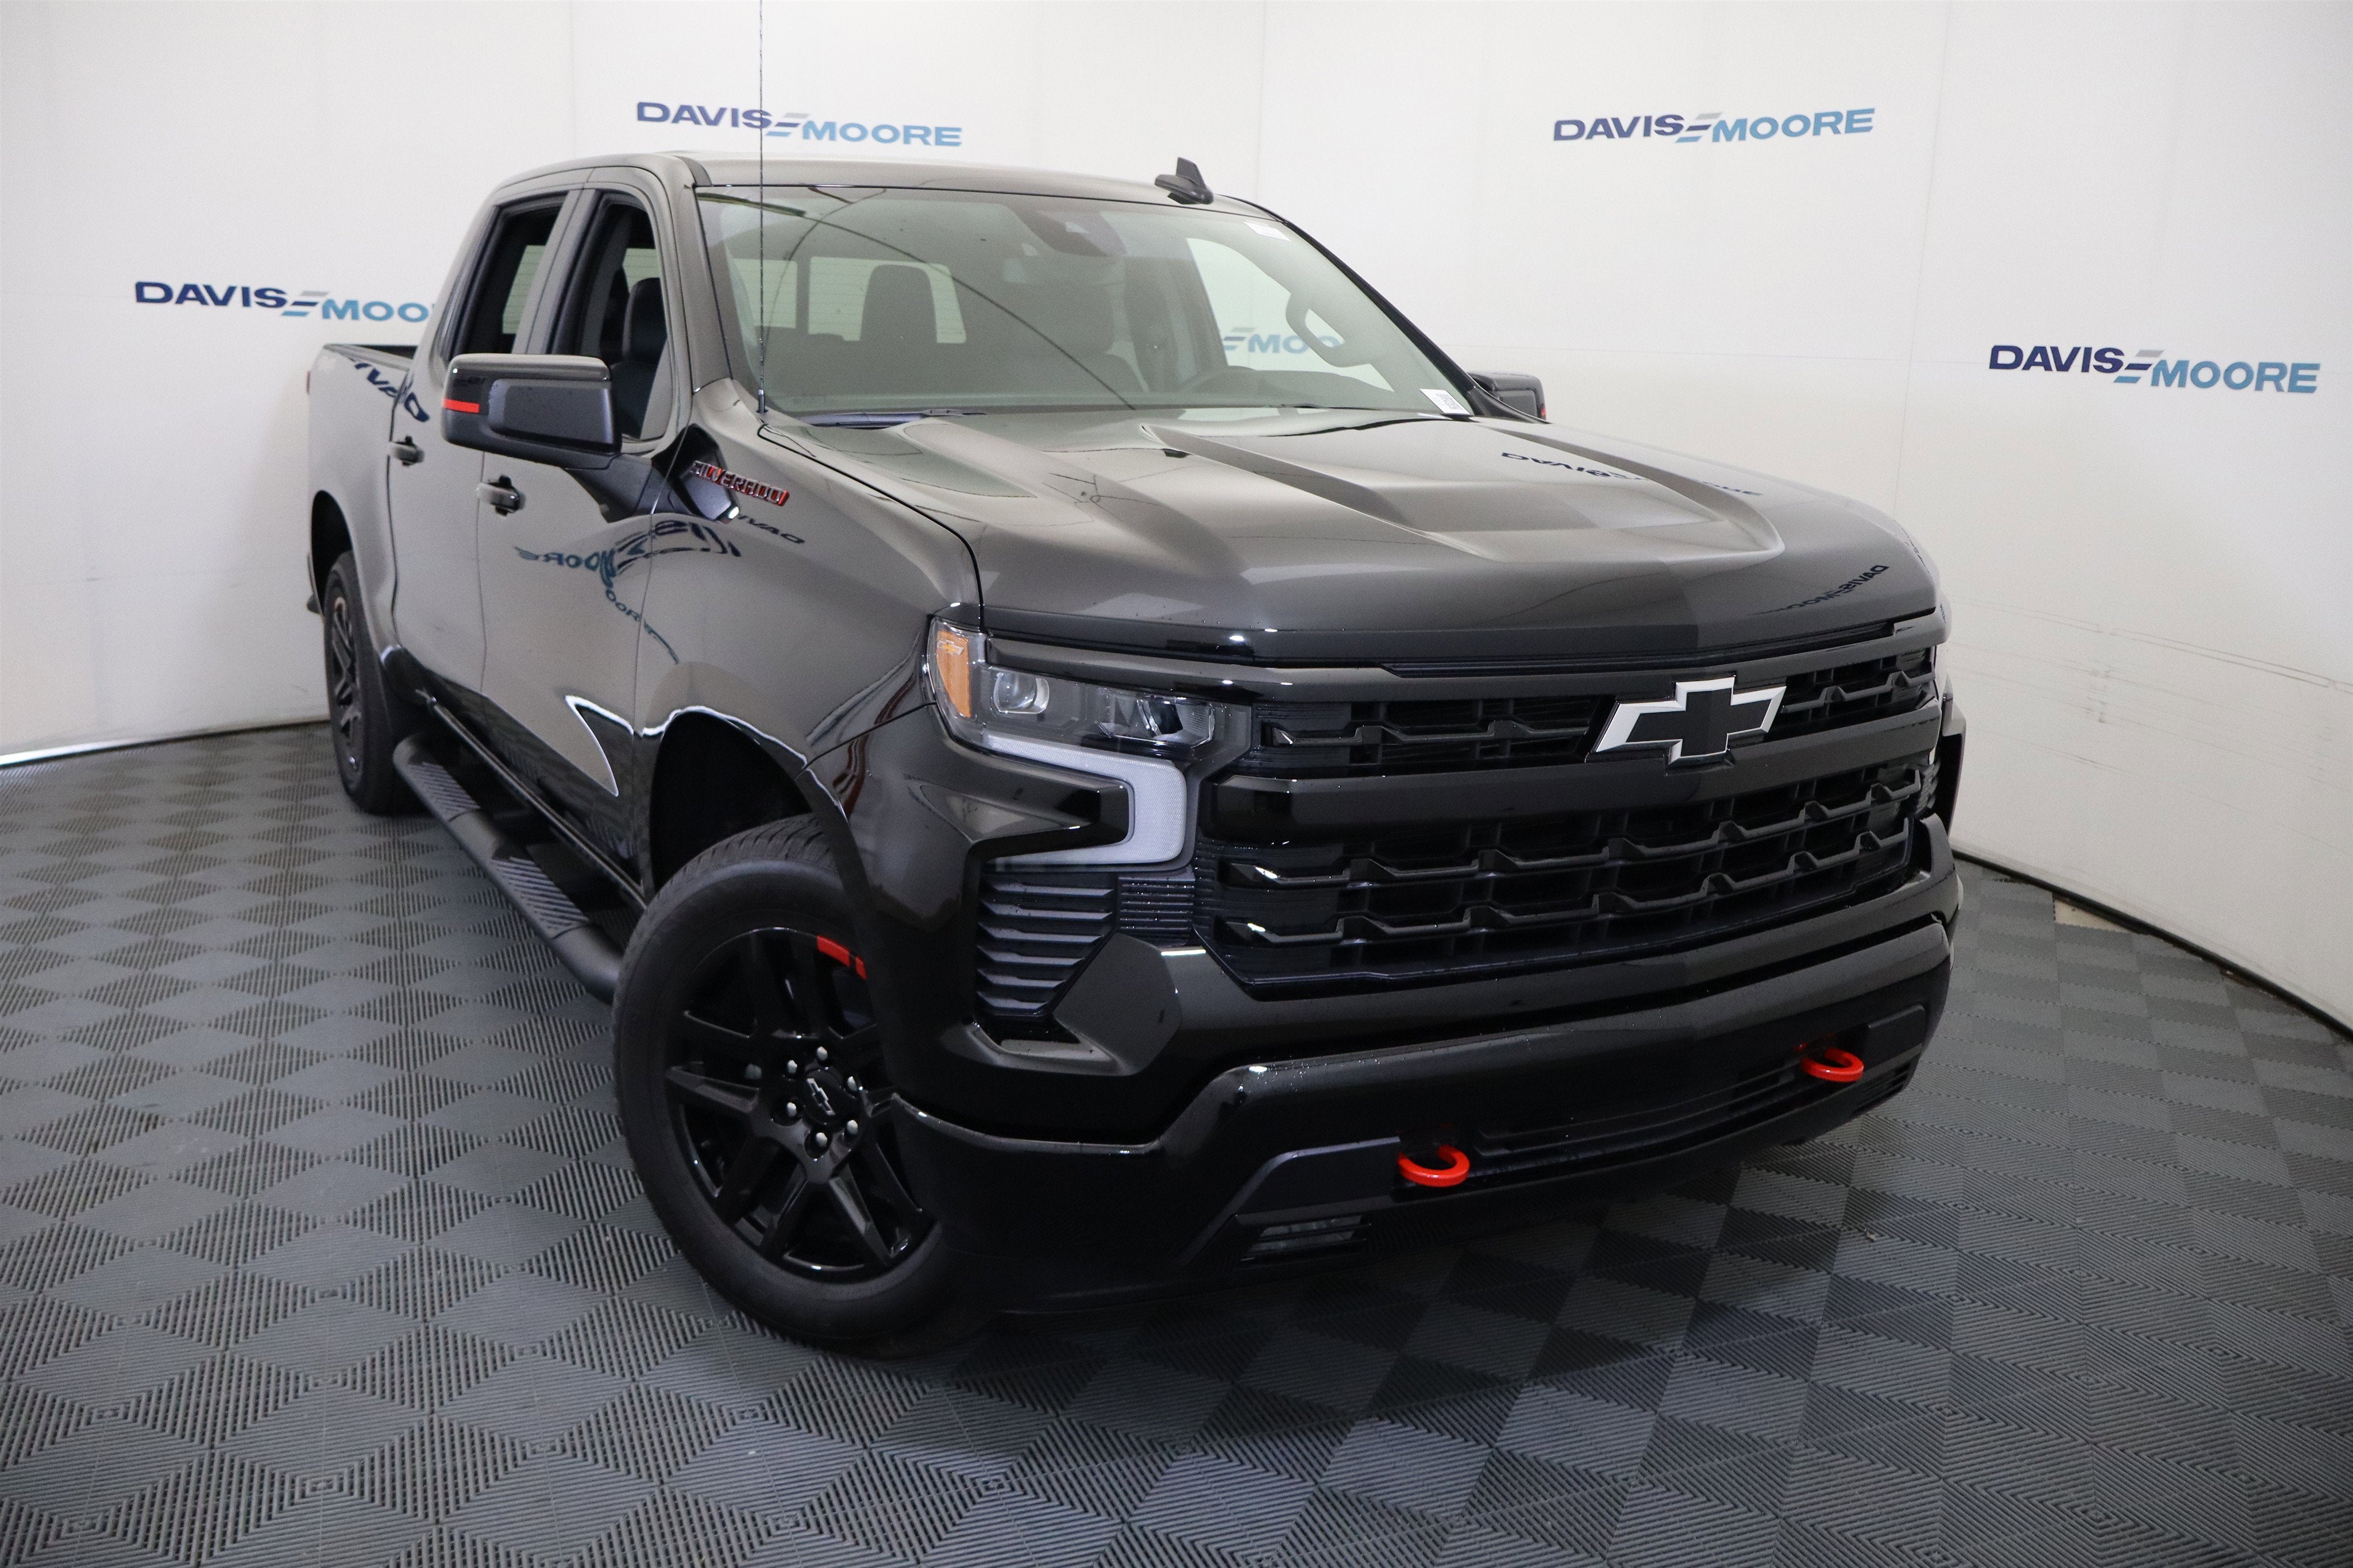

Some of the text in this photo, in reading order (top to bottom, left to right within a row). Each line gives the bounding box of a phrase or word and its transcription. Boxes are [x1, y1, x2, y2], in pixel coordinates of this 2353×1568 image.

[637, 101, 962, 147] DAVIS MOORE
[1553, 108, 1875, 143] DAVIS MOORE
[135, 280, 435, 323] DAVIS MOO
[1988, 345, 2321, 394] DAVIS MOORE
